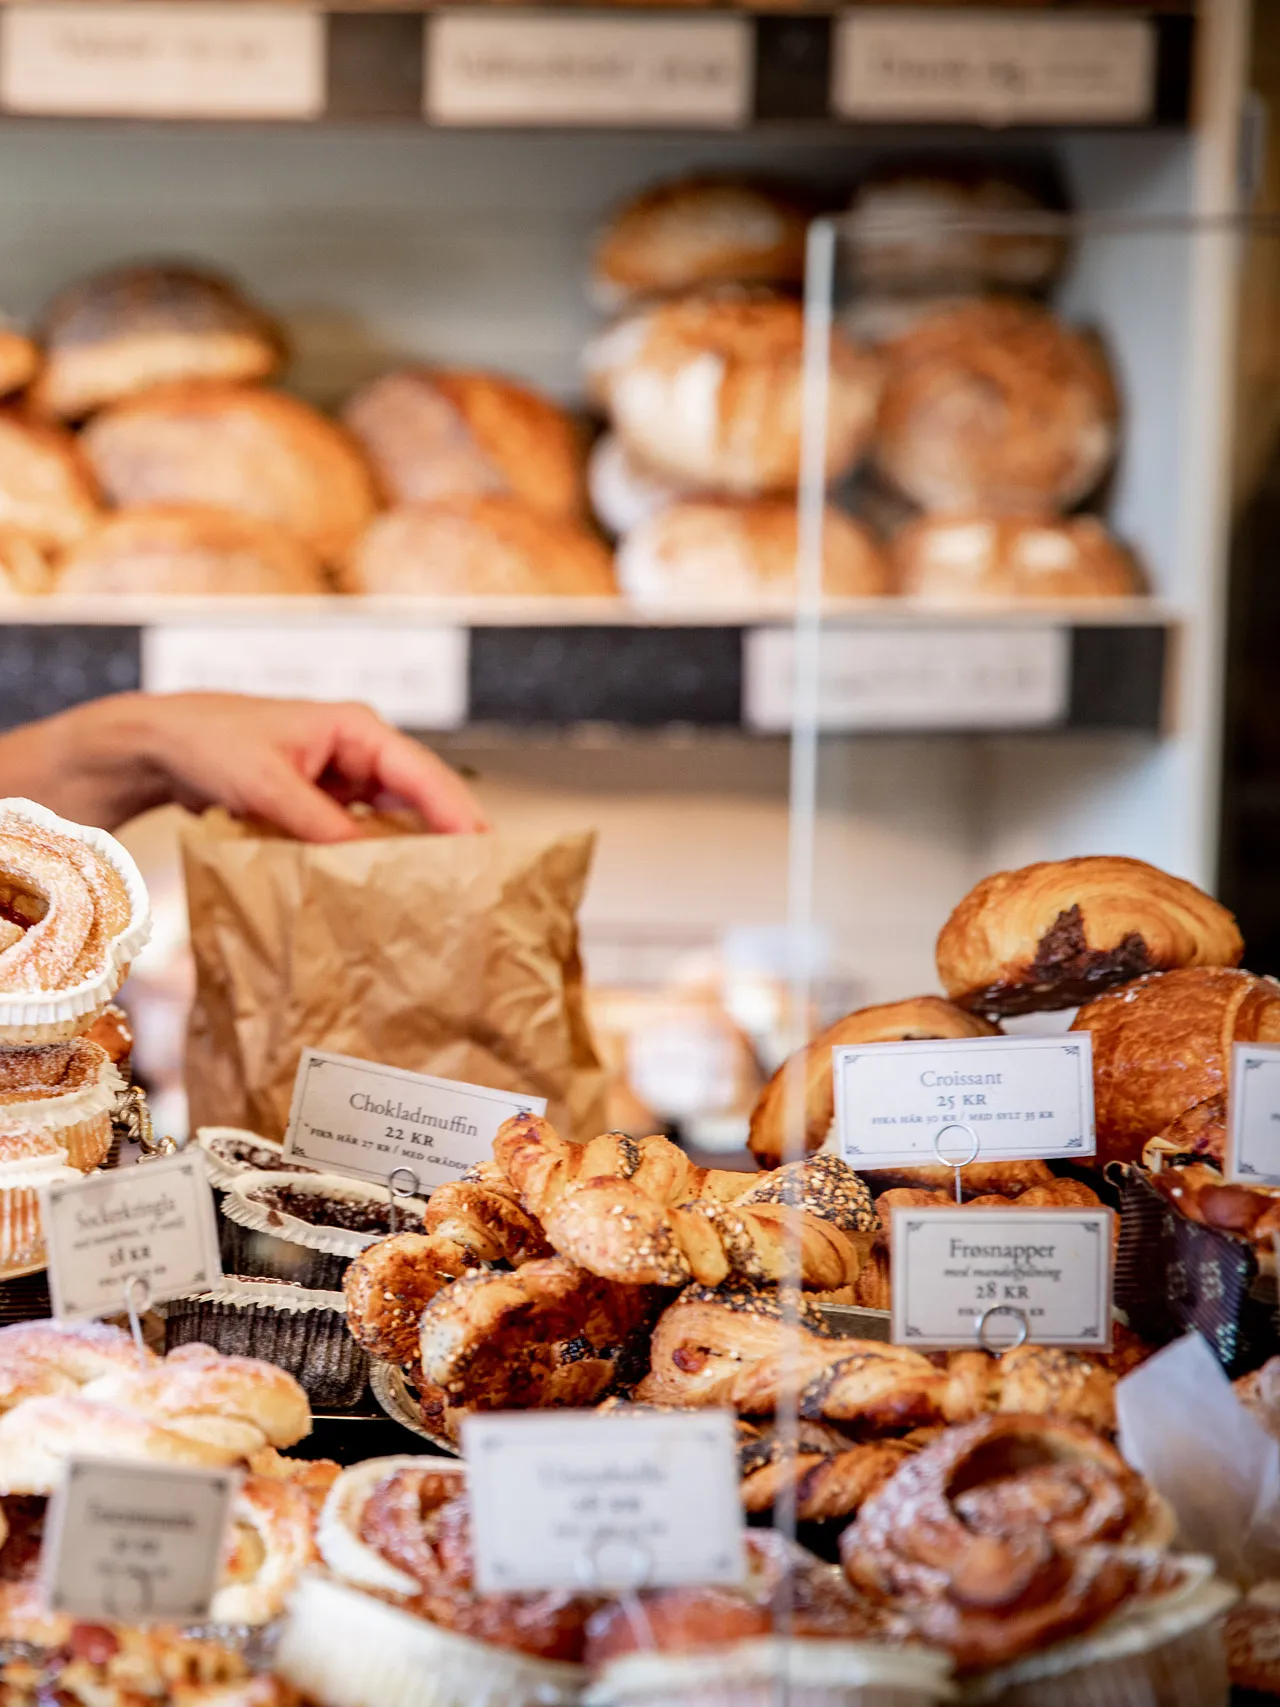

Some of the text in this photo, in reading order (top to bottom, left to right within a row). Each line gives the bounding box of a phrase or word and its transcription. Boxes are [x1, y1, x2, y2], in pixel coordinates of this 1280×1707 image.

[919, 1070, 1004, 1088] Croissant
[937, 1094, 987, 1110] 25 KR
[349, 1093, 478, 1137] Chokladmuffin
[942, 1114, 957, 1123] KR
[969, 1112, 994, 1122] MED
[1038, 1110, 1056, 1120] KR
[310, 1127, 335, 1141] FIKA
[336, 1134, 359, 1146] HÄR
[376, 1142, 391, 1154] KR
[401, 1149, 426, 1162] MED
[384, 1126, 436, 1149] 22 KR
[949, 1238, 1056, 1265] Frøsnapper
[975, 1280, 1031, 1299] 28 KR
